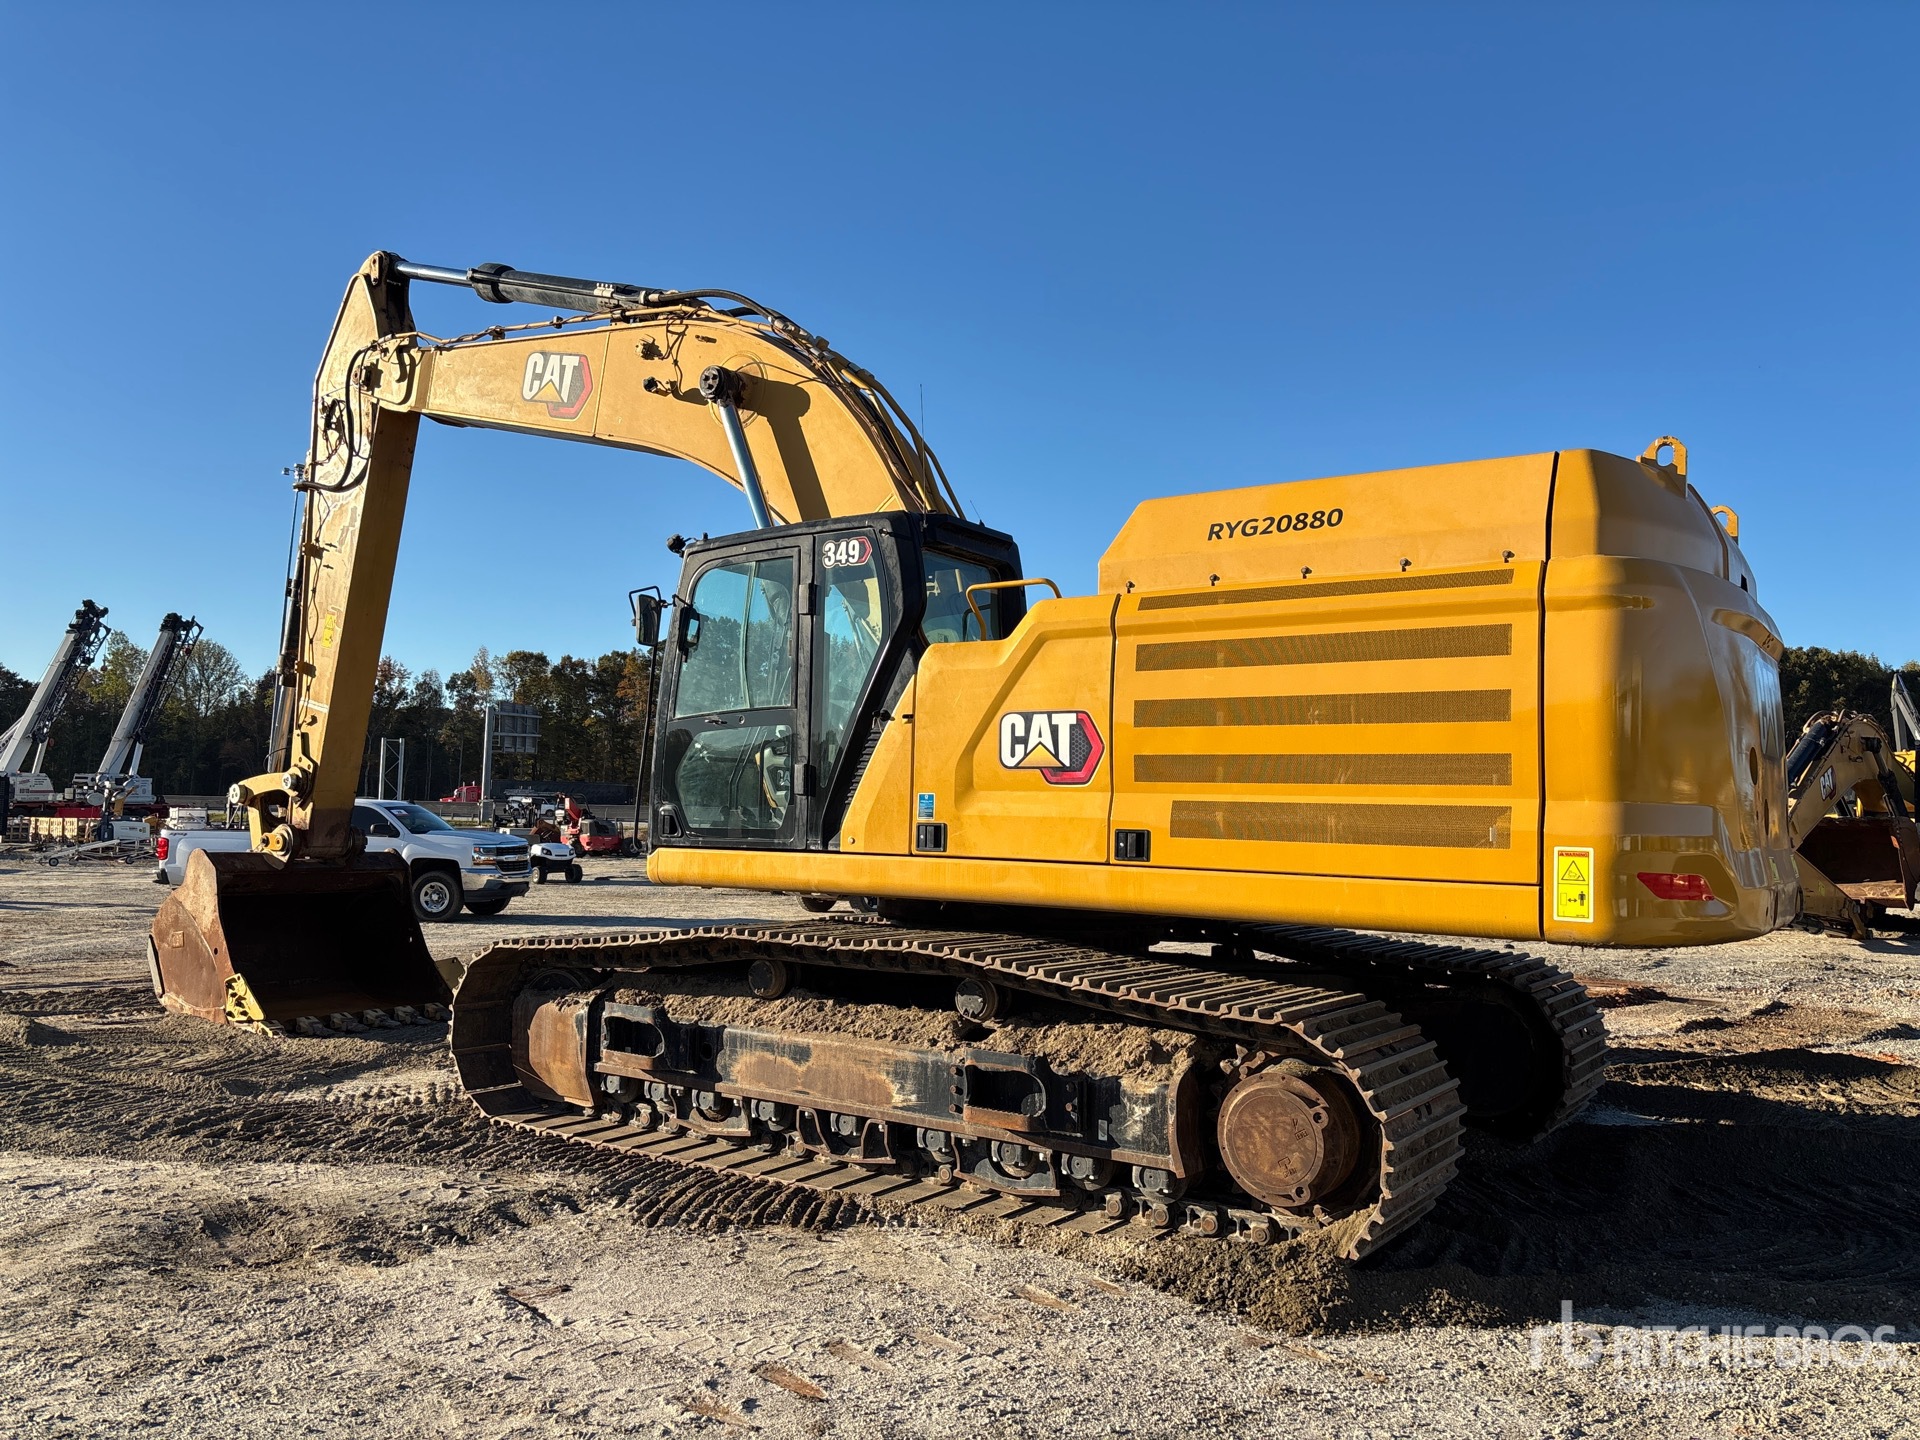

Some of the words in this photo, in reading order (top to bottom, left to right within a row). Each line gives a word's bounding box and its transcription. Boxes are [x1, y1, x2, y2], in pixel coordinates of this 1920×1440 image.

[522, 352, 580, 403] CAT
[1207, 508, 1344, 541] RYG20880
[824, 539, 860, 566] 349
[1001, 712, 1077, 768] CAT
[1820, 767, 1834, 800] CAT
